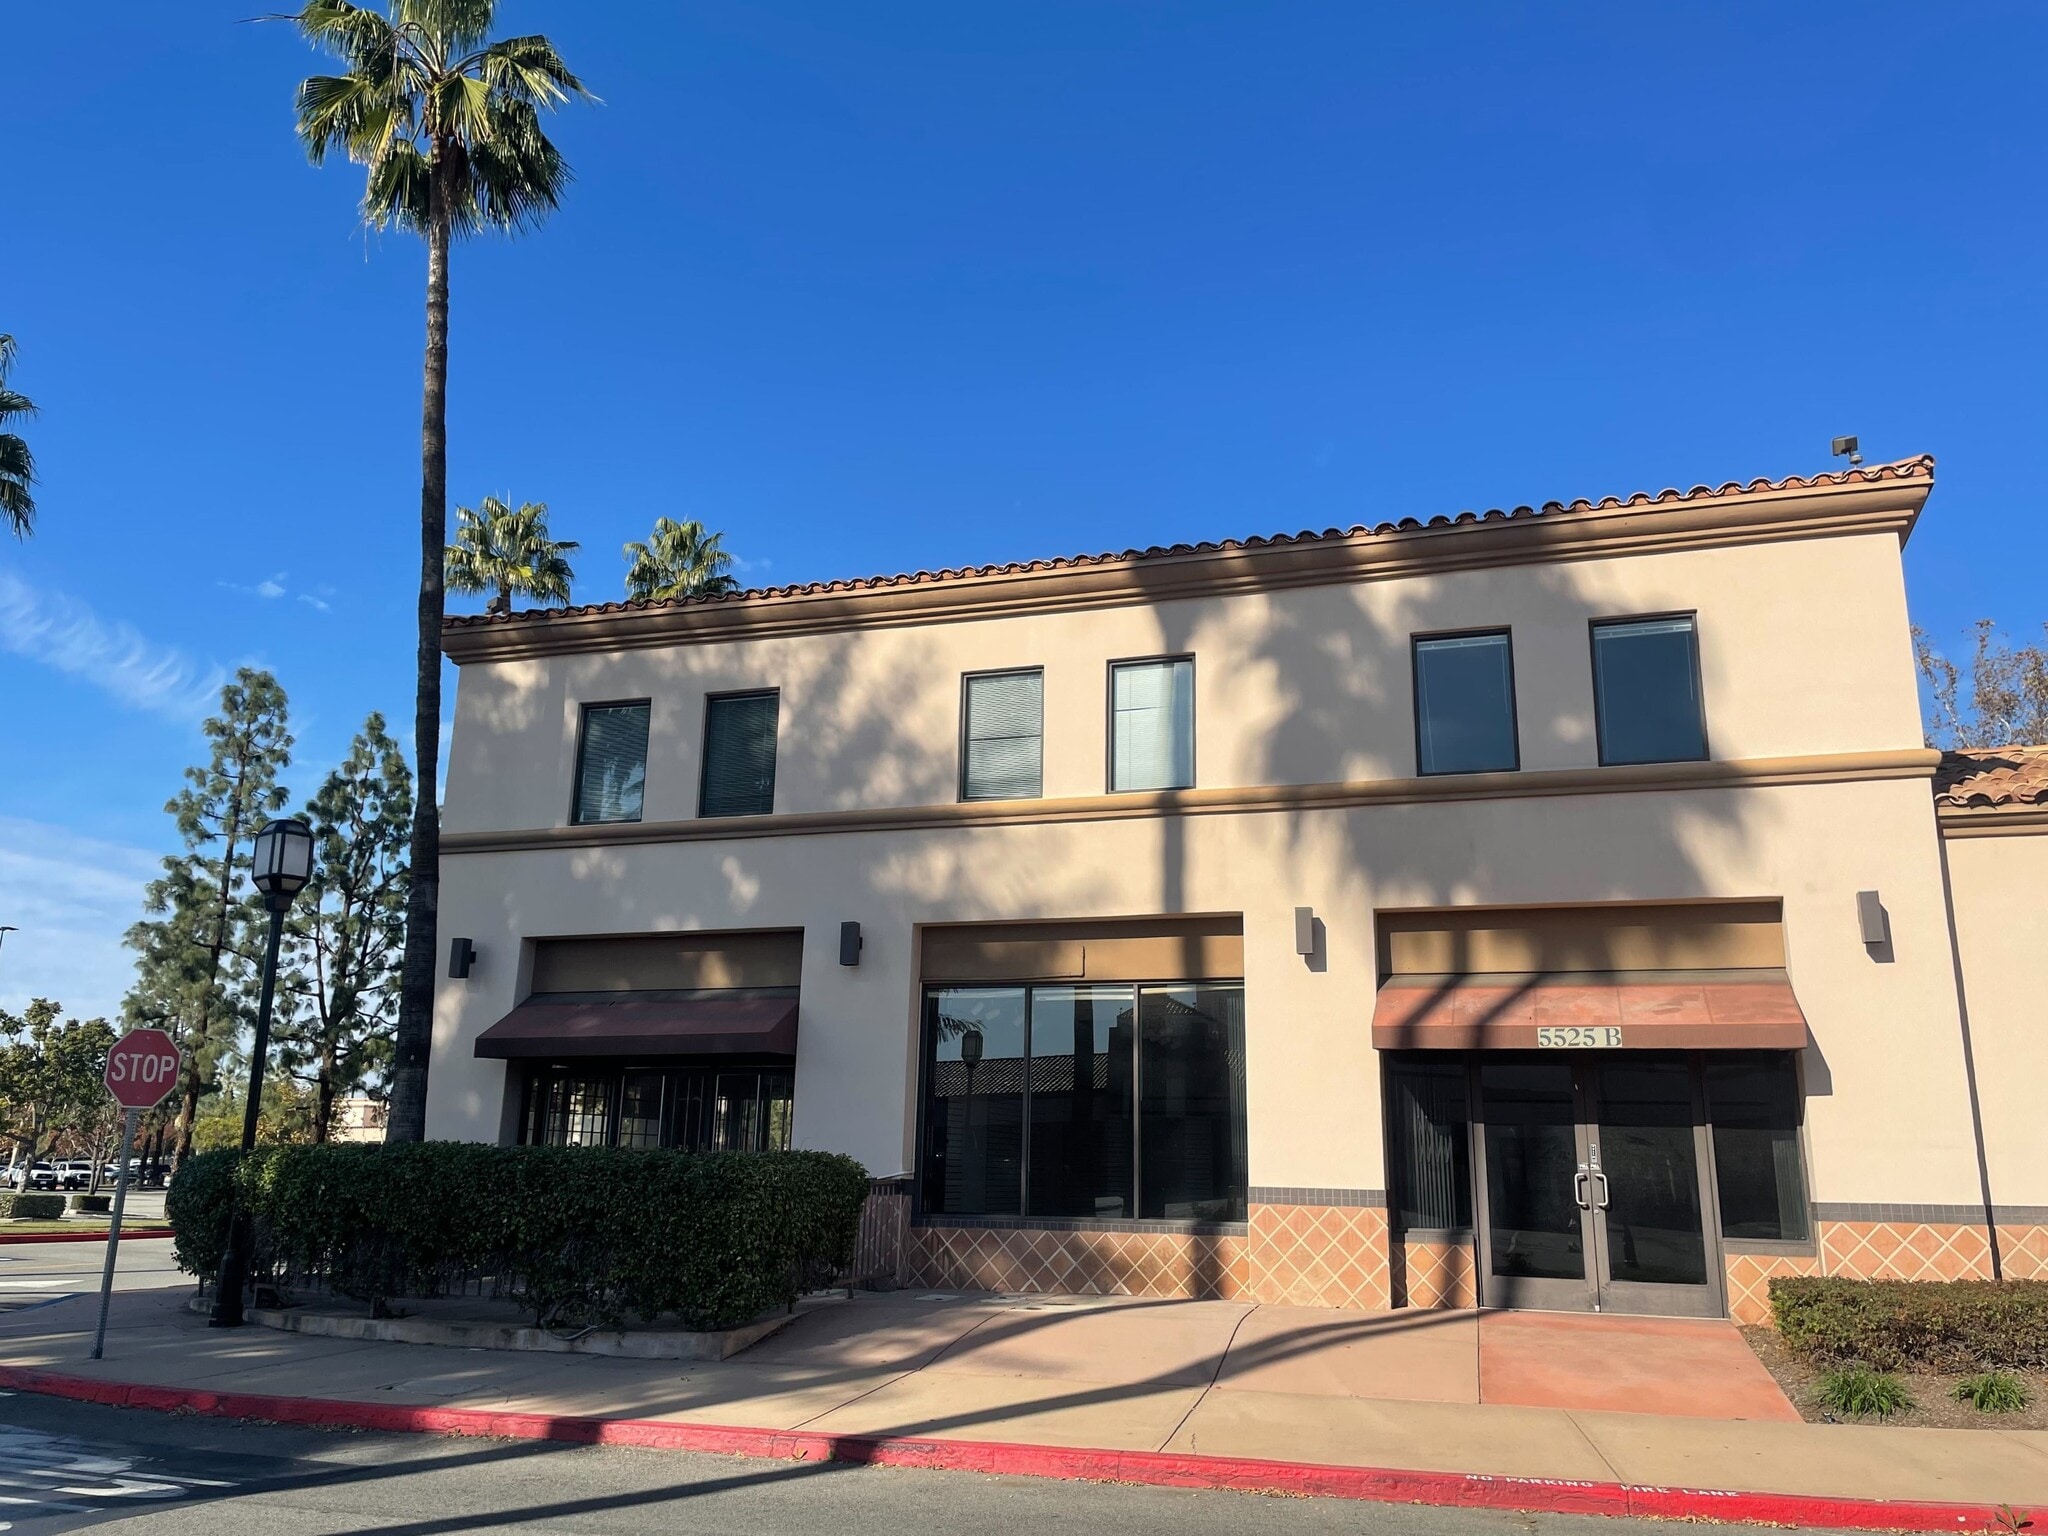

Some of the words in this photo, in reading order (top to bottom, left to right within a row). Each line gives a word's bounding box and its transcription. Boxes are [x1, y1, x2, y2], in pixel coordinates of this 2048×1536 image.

[1539, 1028, 1596, 1047] 5525
[1604, 1027, 1622, 1046] B
[111, 1052, 175, 1083] STOP
[1465, 1473, 1493, 1481] NO
[1505, 1476, 1594, 1488] PARKING
[1682, 1488, 1740, 1497] LANE
